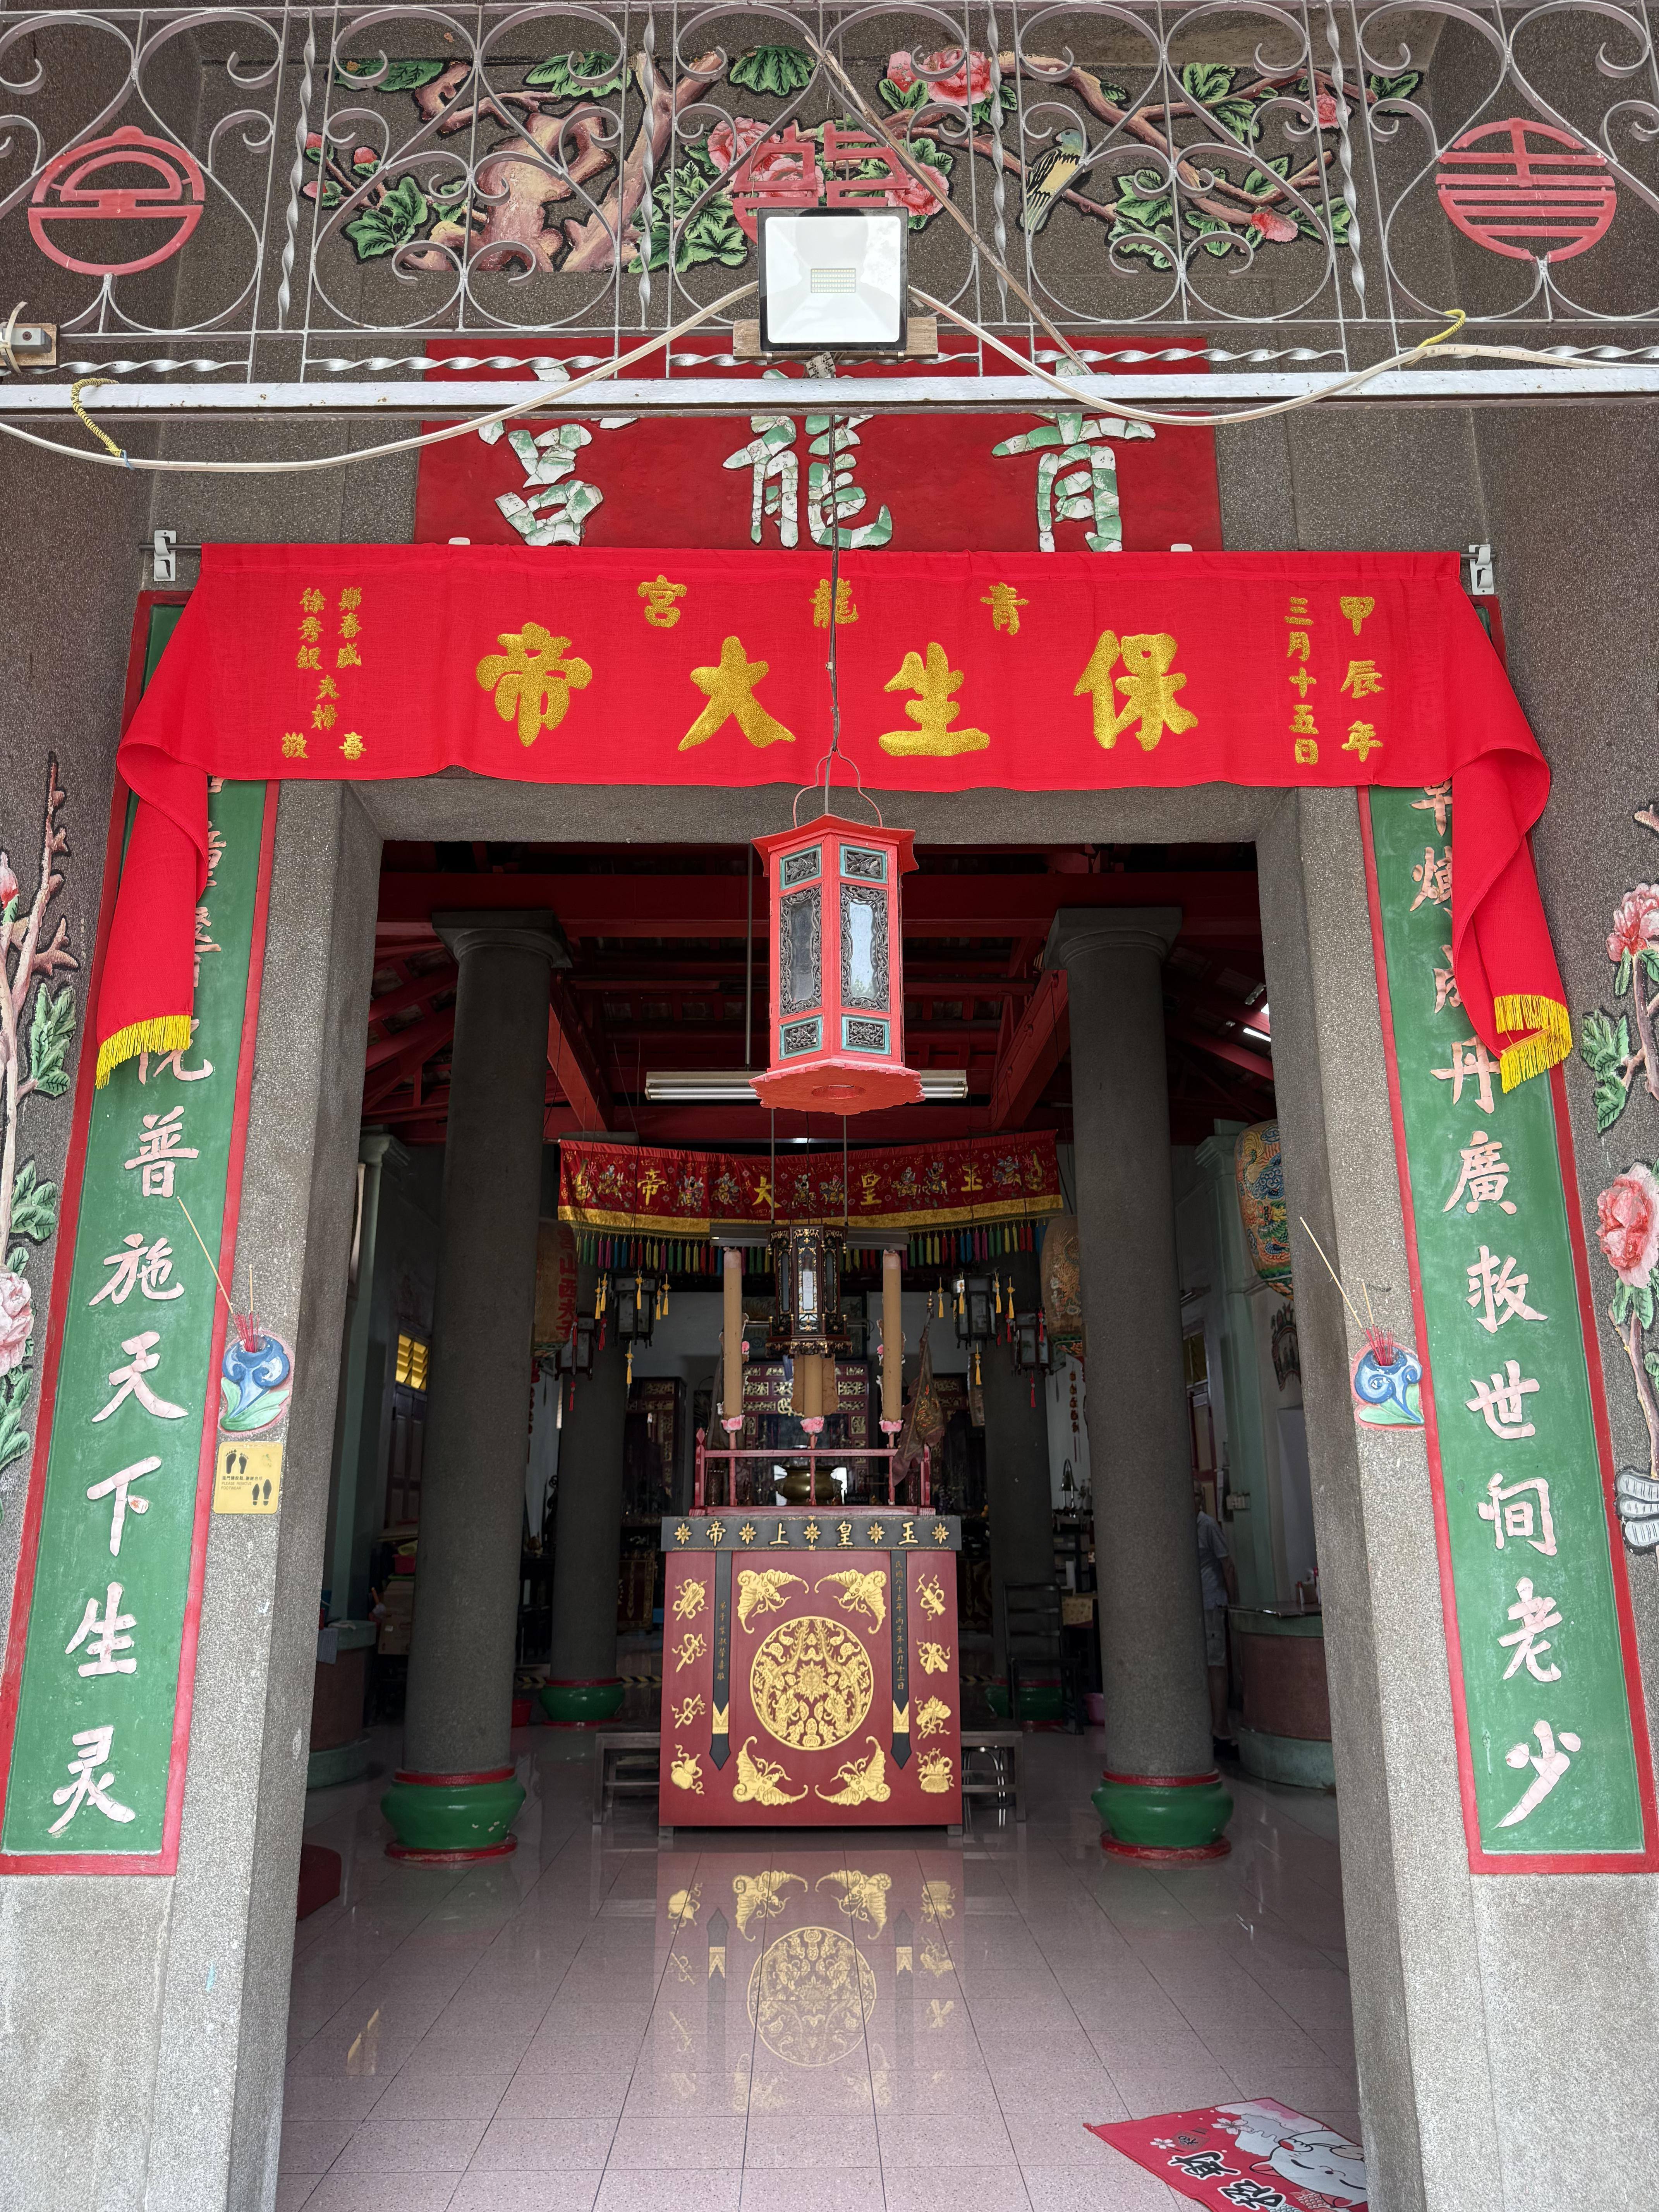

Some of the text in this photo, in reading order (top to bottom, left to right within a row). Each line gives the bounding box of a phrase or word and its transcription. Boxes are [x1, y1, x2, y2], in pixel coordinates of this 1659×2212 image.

[637, 575, 1029, 635] 青龍宮
[476, 622, 1198, 752] 保生大帝
[1285, 597, 1318, 765] 三月十五日
[1340, 596, 1384, 762] 甲辰年
[706, 1521, 919, 1547] 玉皇上帝
